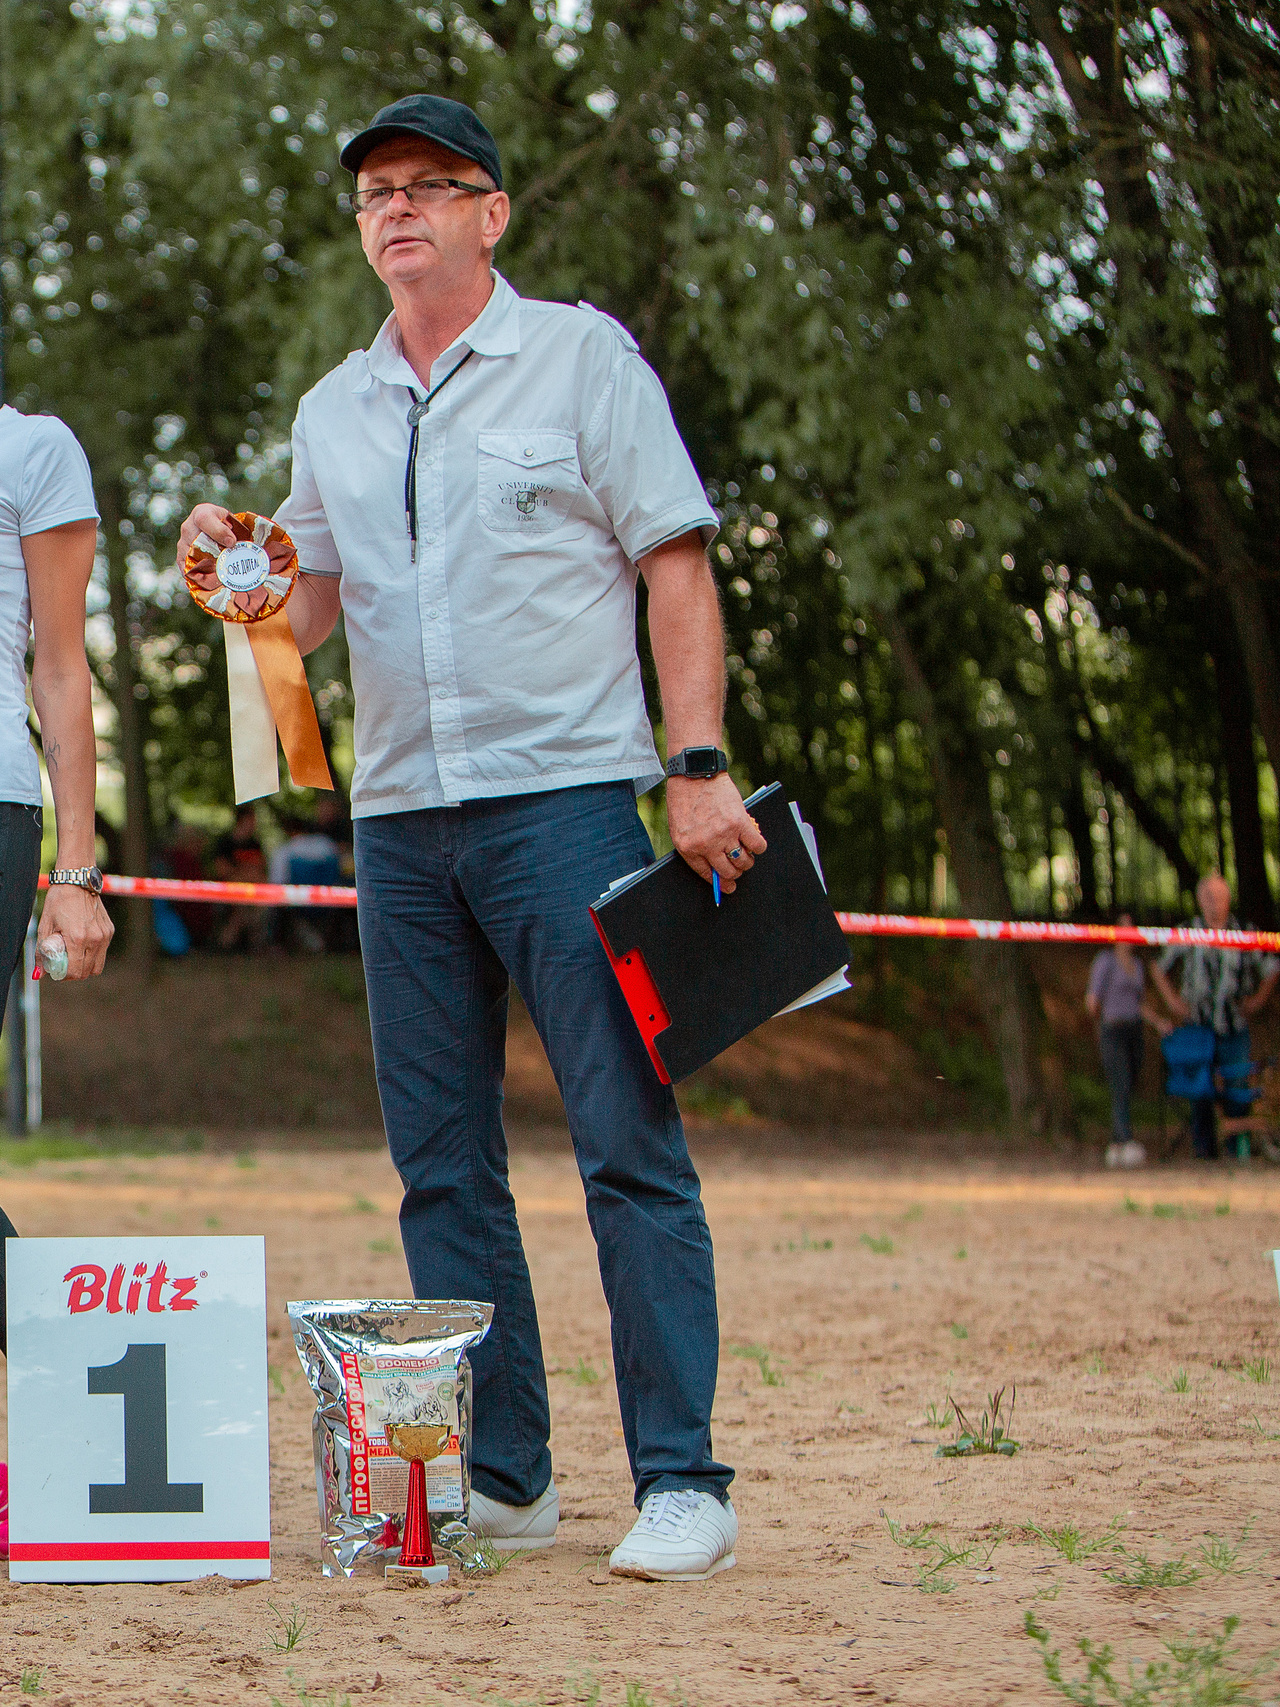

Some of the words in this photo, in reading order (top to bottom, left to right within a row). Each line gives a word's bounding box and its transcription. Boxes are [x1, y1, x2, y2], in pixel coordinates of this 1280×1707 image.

[498, 481, 556, 494] UNIVERSITY
[378, 1358, 438, 1368] ЗООМЕНЮ
[87, 1343, 204, 1514] 1
